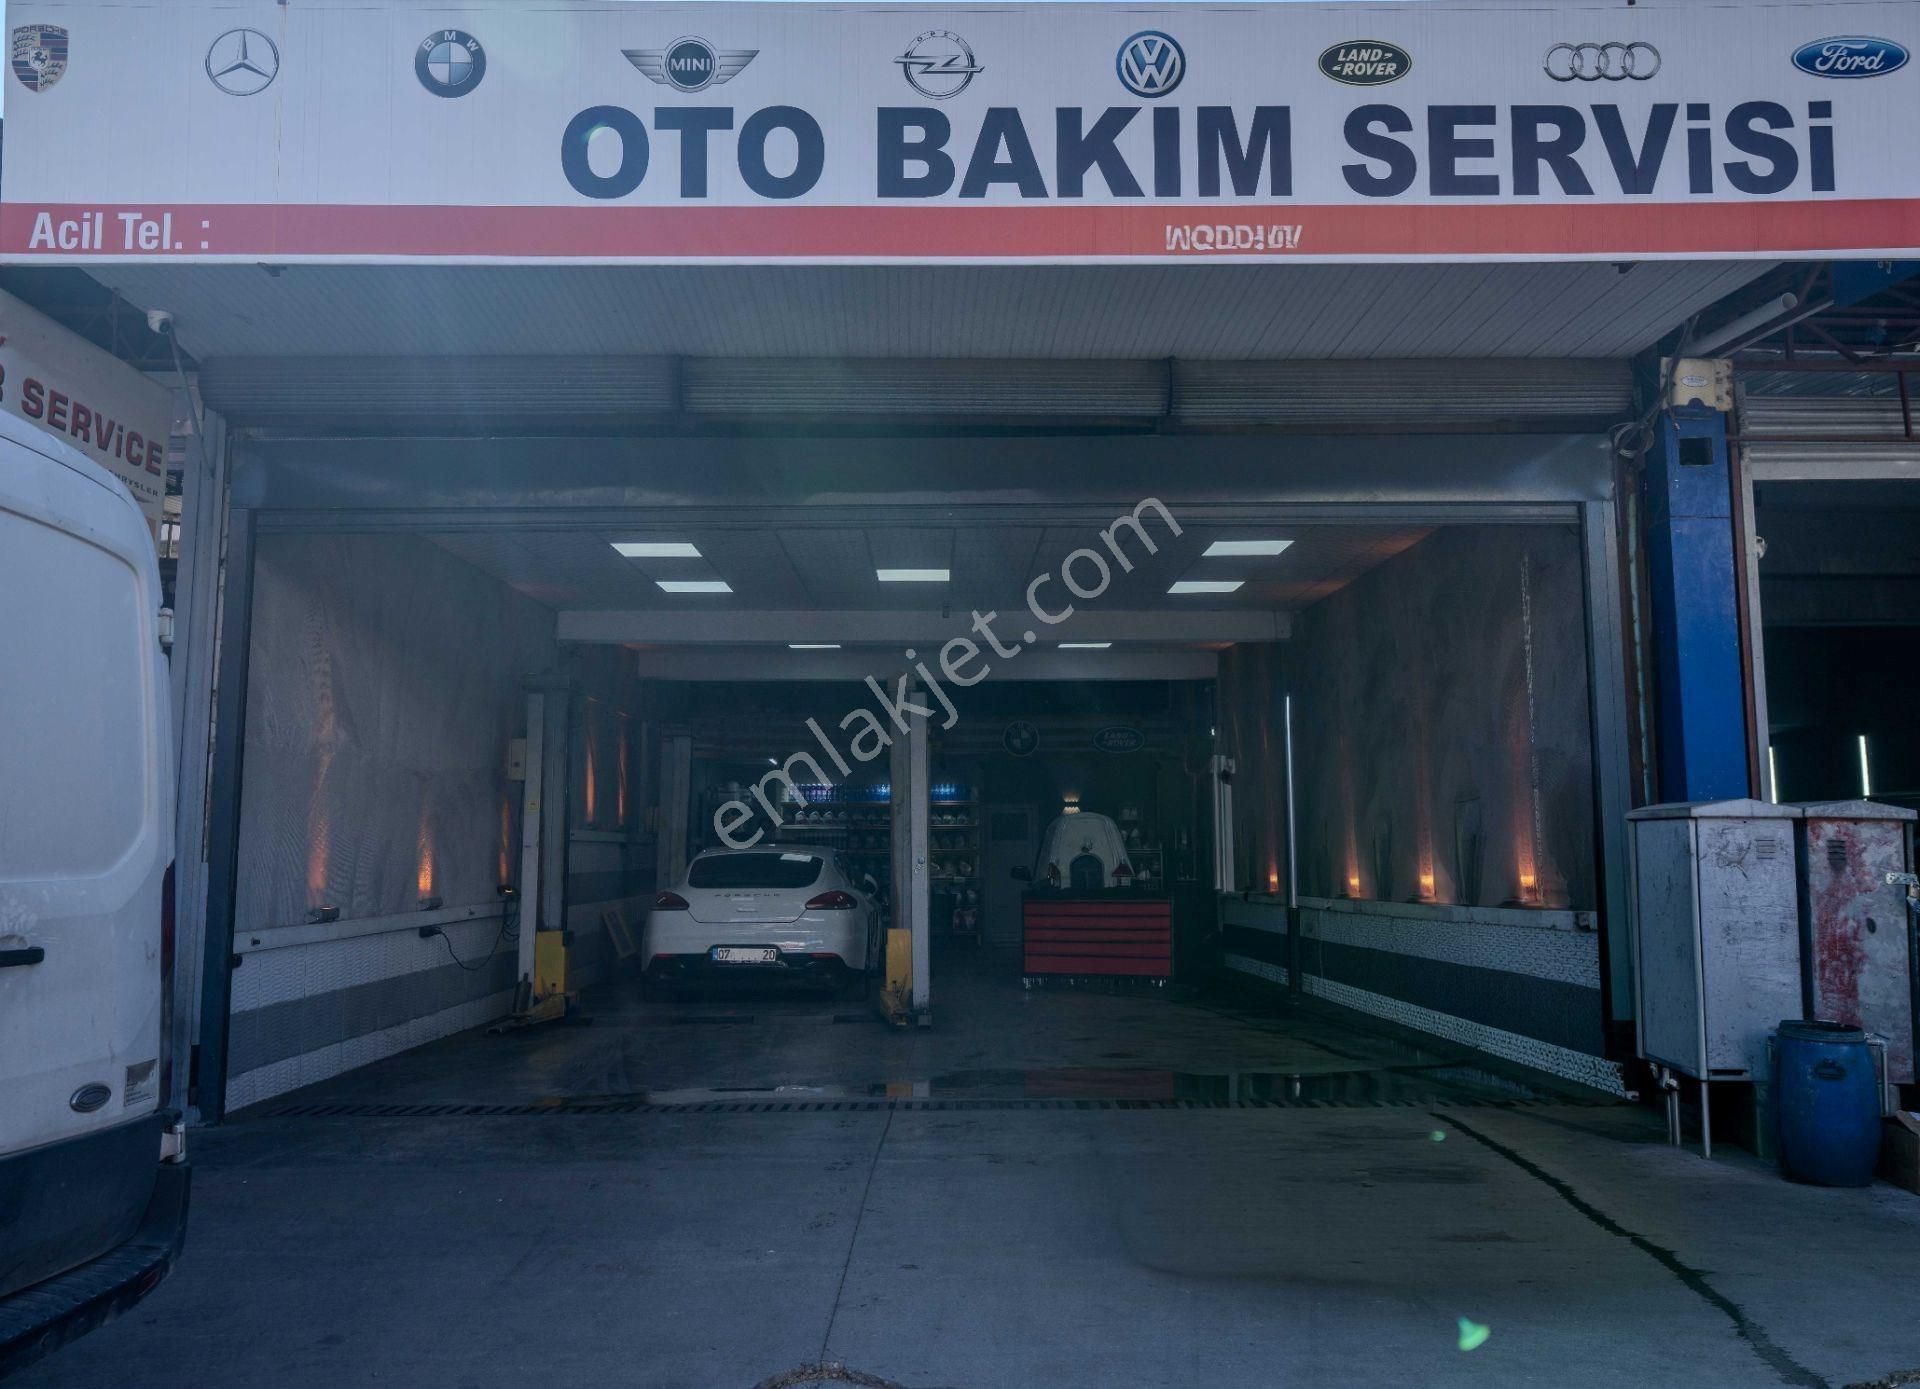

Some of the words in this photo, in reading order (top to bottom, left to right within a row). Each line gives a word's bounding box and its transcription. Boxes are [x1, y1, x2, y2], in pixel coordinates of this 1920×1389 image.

[13, 24, 69, 37] PORSCHE
[916, 30, 960, 43] OPEL
[422, 31, 479, 52] BMW
[1337, 48, 1383, 62] LAND
[1814, 42, 1886, 71] Ford
[670, 58, 711, 71] MINI
[1341, 62, 1397, 76] ROVER
[561, 105, 826, 200] OTO
[876, 105, 1292, 199] BAKIM
[29, 212, 103, 250] Acil
[117, 212, 184, 250] Tel.
[718, 949, 730, 961] 07
[762, 949, 776, 961] 20
